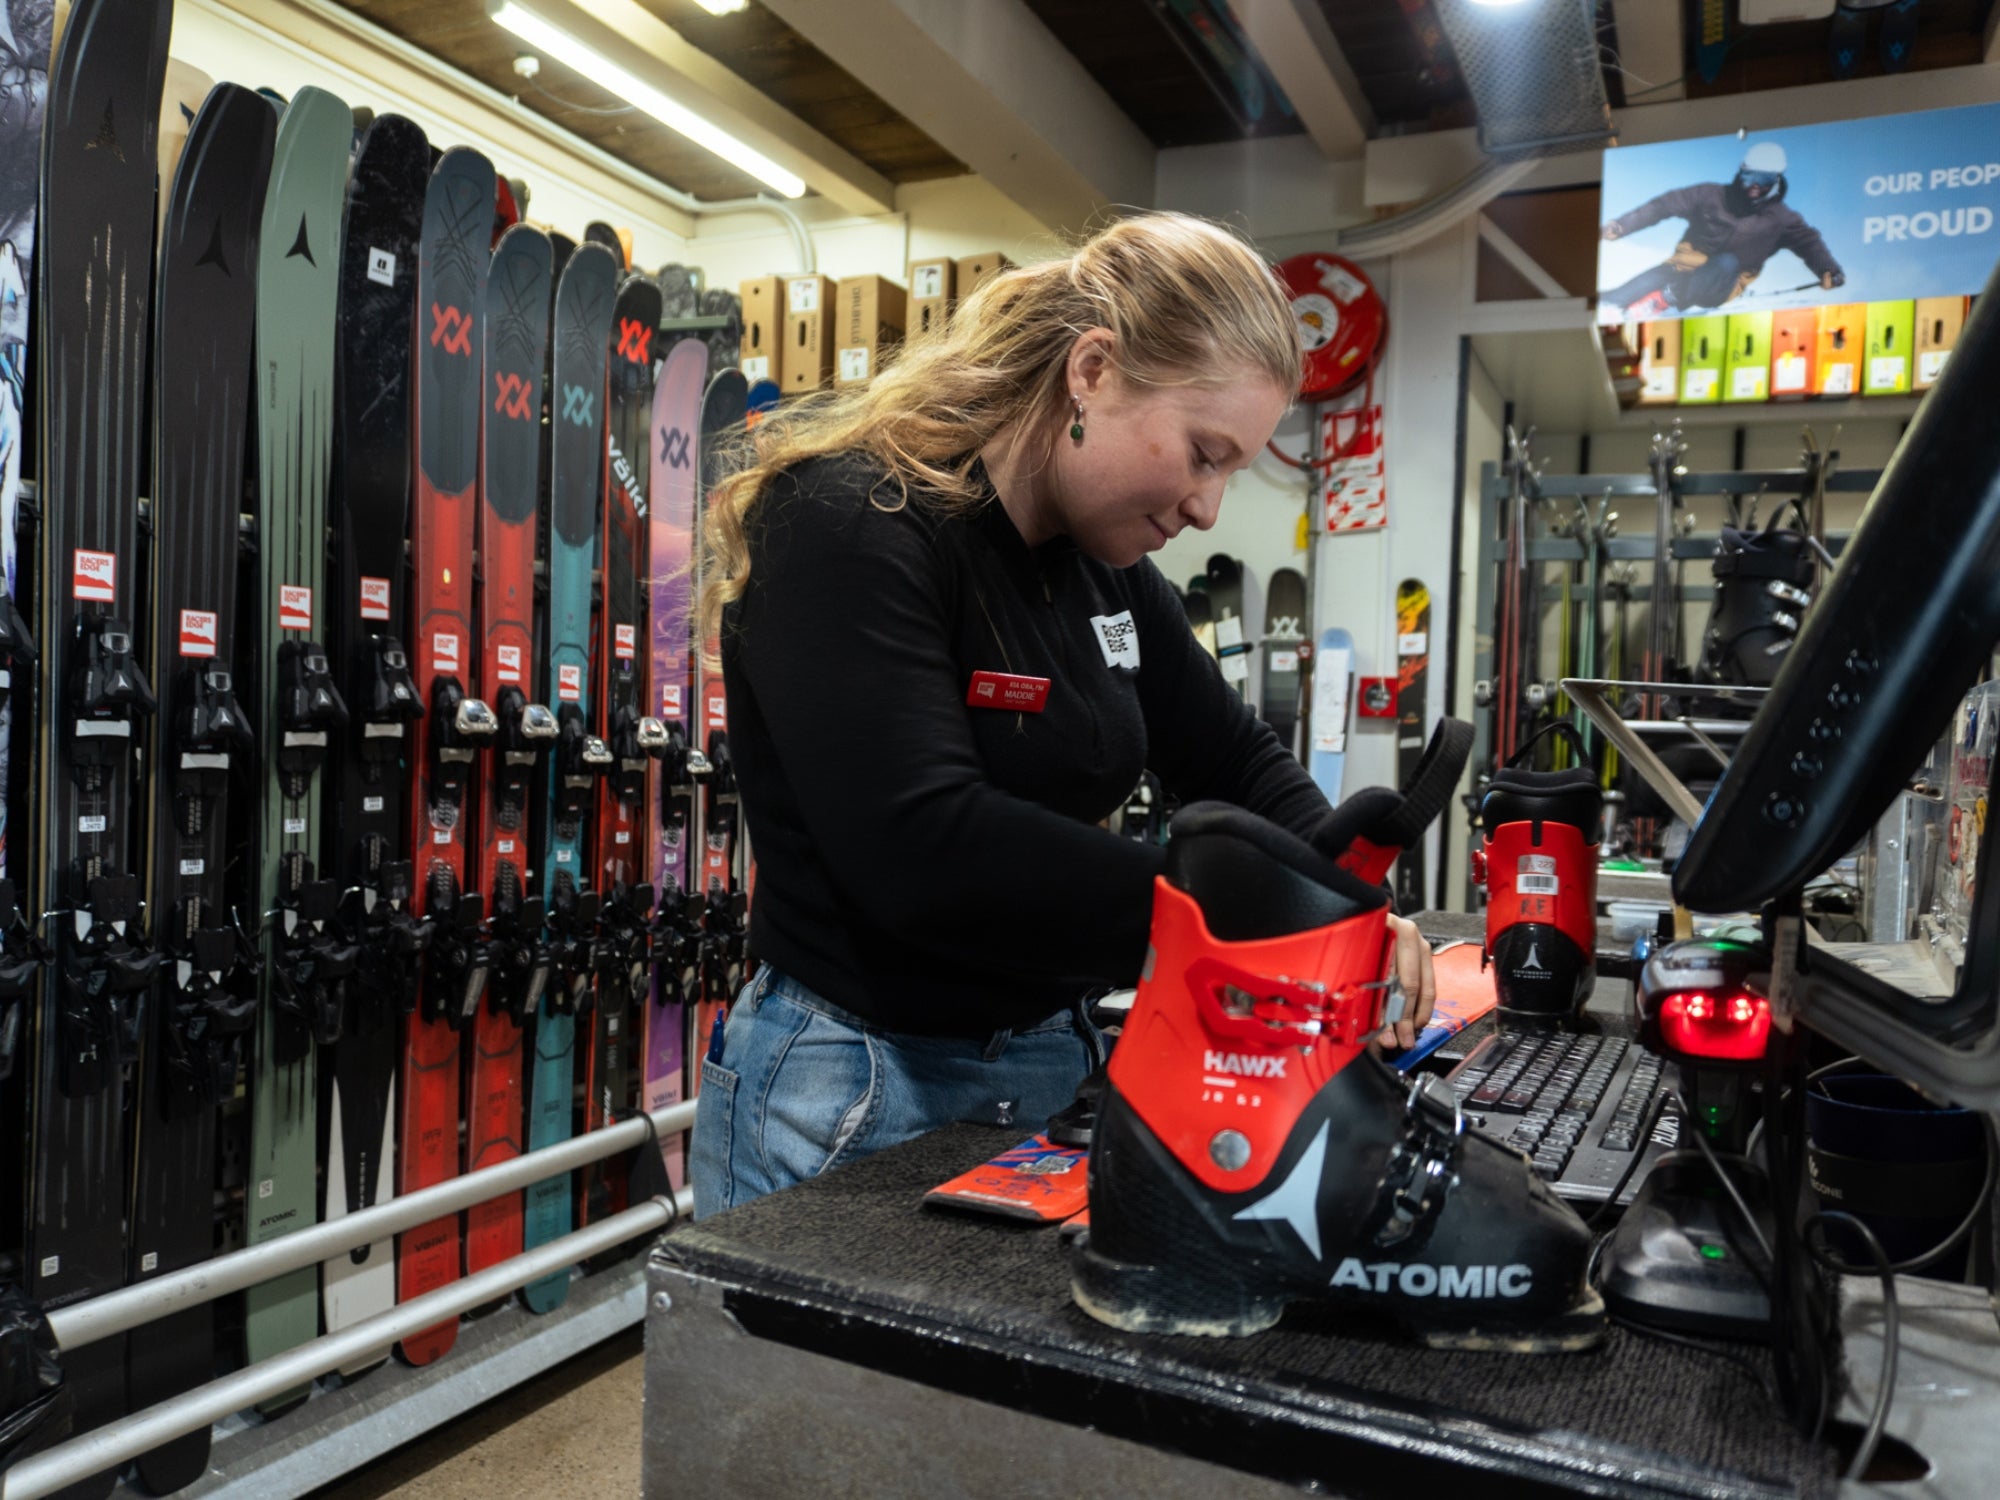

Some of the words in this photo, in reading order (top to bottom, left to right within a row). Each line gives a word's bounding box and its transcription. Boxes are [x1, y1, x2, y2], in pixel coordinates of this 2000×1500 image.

[1864, 171, 1923, 196] OUR
[1863, 206, 1994, 244] PROUD
[1204, 1049, 1287, 1078] HAWX
[260, 1208, 297, 1227] ATOMIC
[1329, 1257, 1533, 1298] ATOMIC
